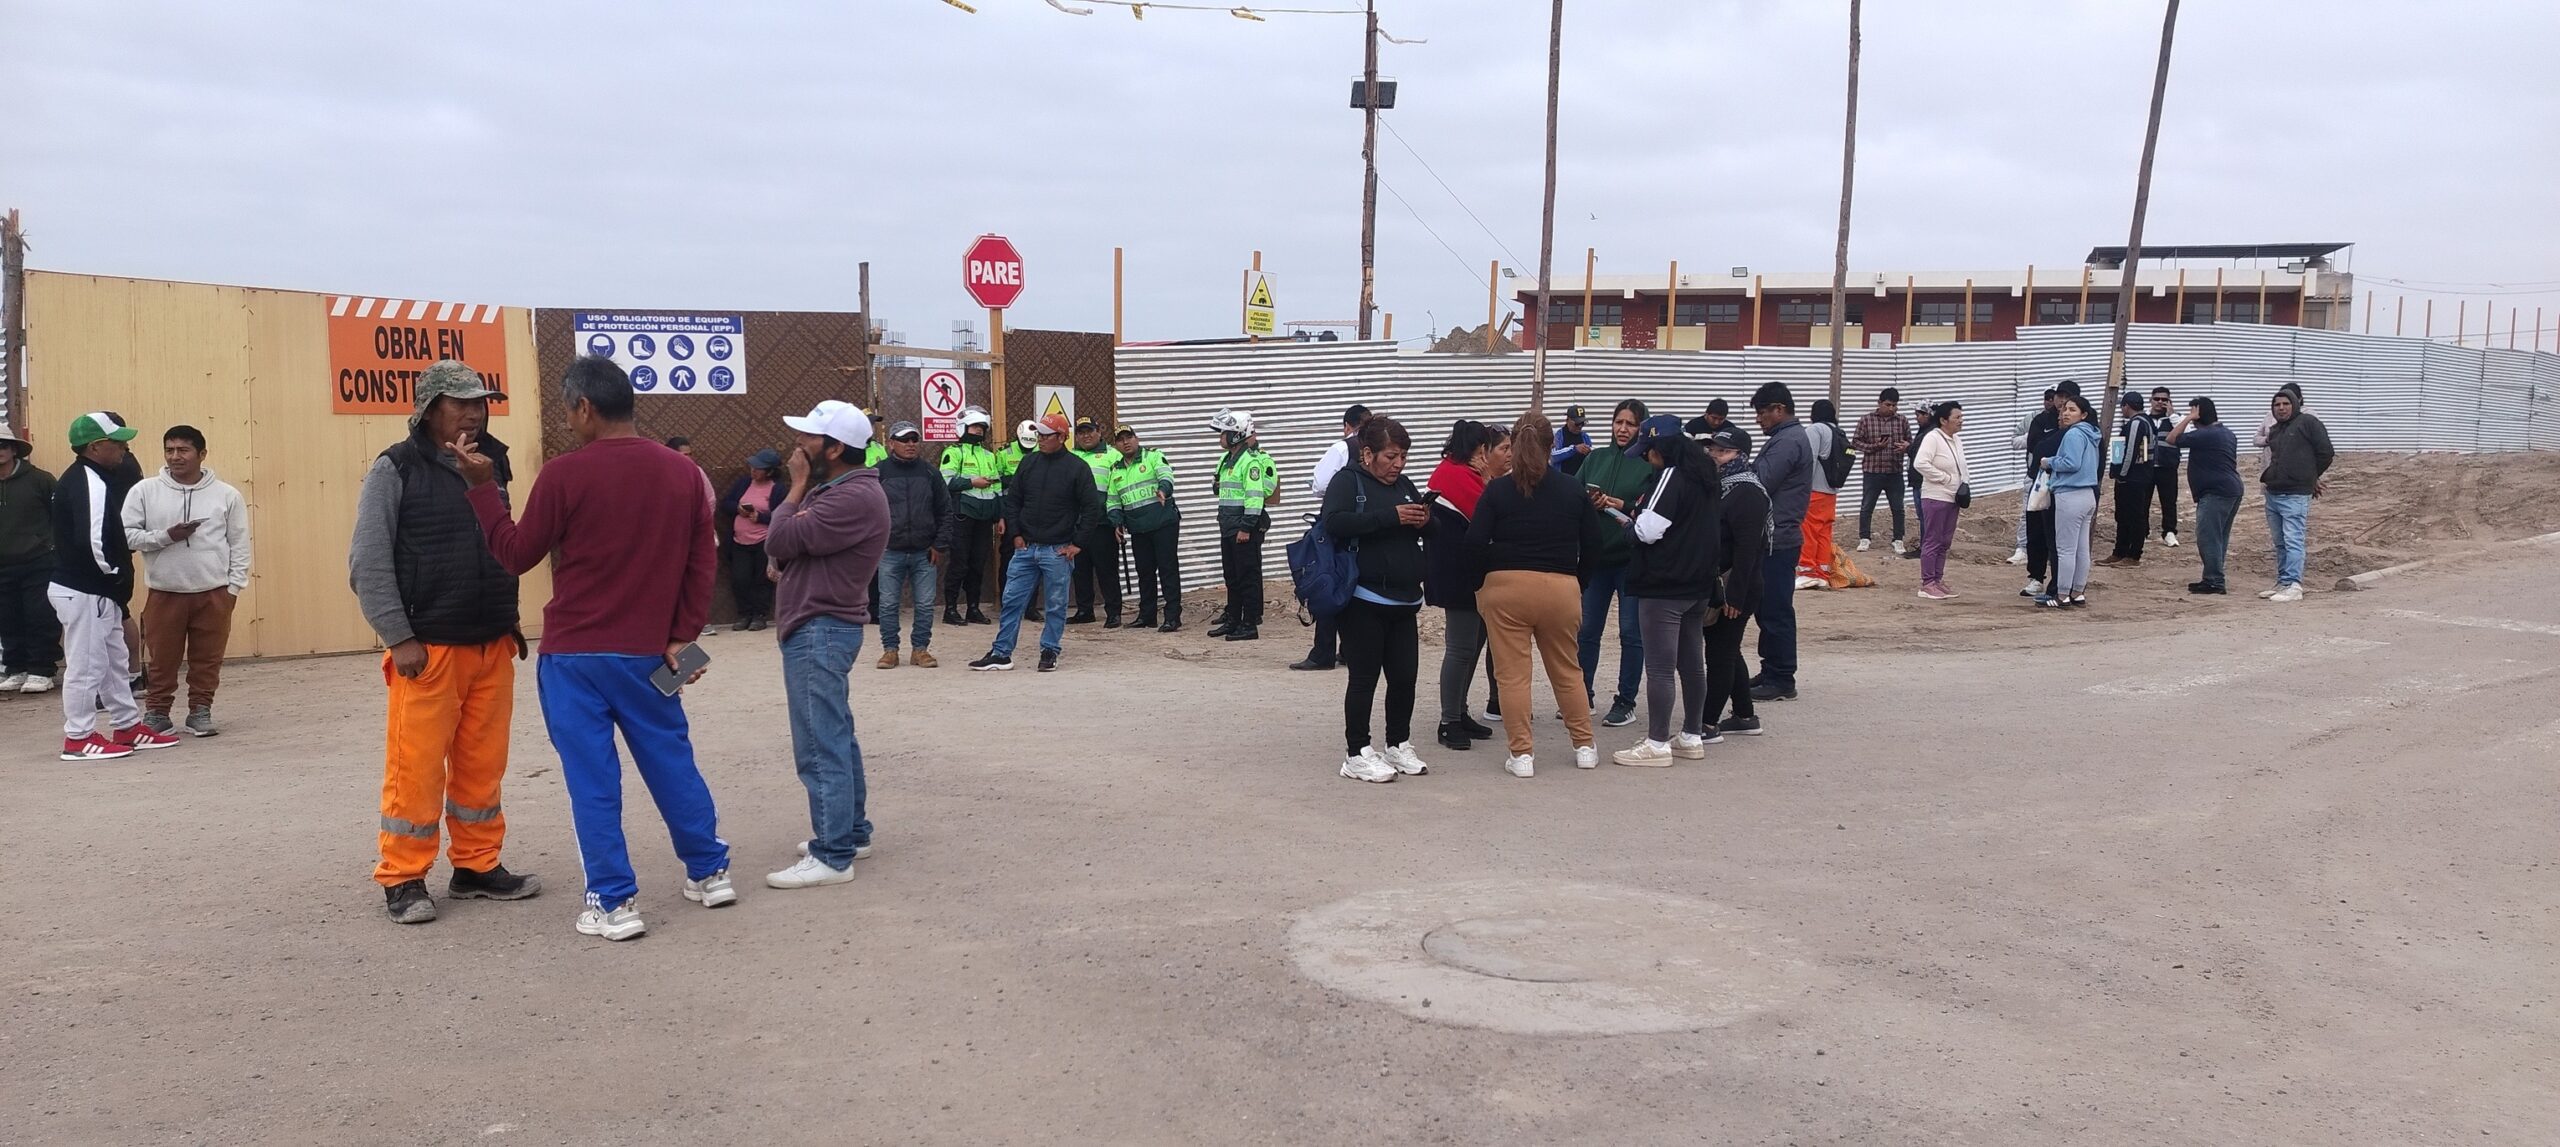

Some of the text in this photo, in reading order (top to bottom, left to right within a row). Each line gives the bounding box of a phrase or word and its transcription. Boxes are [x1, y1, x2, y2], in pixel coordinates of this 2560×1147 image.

[970, 260, 1020, 285] PARE
[582, 322, 735, 333] DE PROTECCIÓN PERSONAL (EPP)
[587, 314, 608, 322] USO
[612, 315, 676, 323] OBLIGATORIO
[374, 325, 465, 361] OBRA EN
[339, 368, 502, 404] CONSTN
